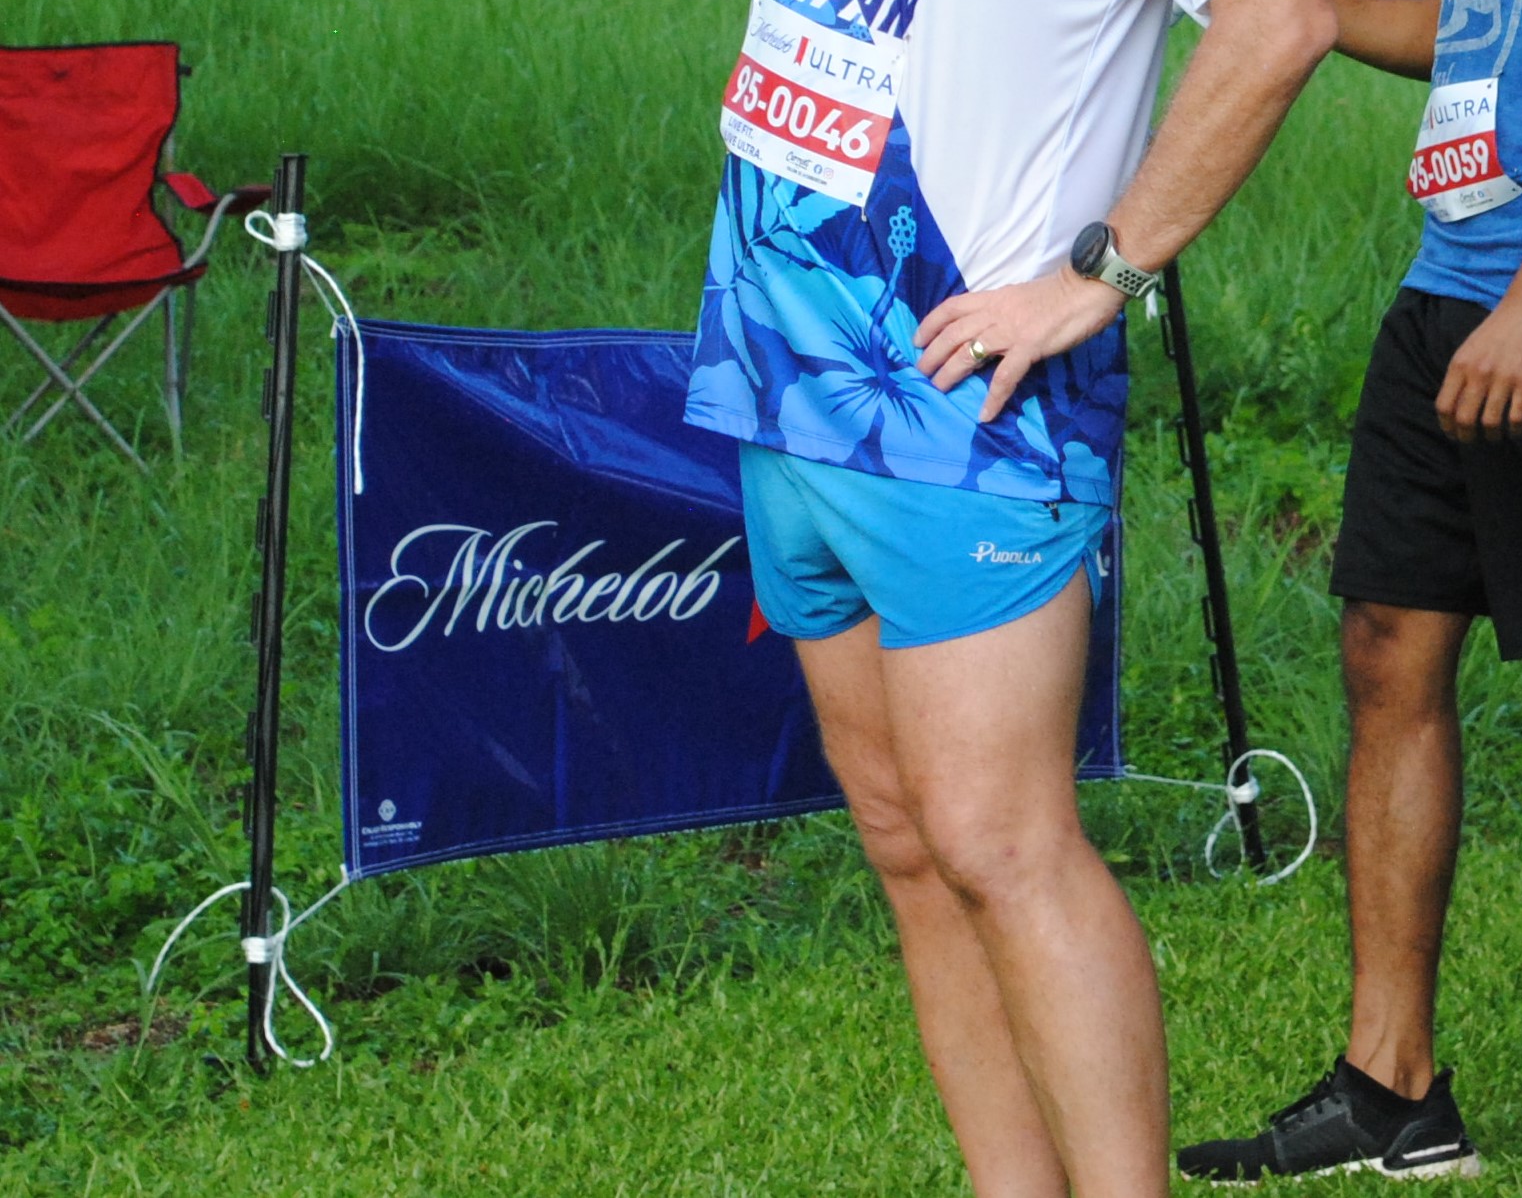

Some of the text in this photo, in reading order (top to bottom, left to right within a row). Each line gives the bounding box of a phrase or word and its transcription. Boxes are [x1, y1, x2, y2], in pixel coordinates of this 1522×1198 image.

[809, 46, 894, 96] ULTRA
[731, 64, 873, 159] 95-0046
[1434, 96, 1490, 126] ULTRA
[1408, 137, 1490, 194] 95-0059
[364, 520, 743, 653] Michelob
